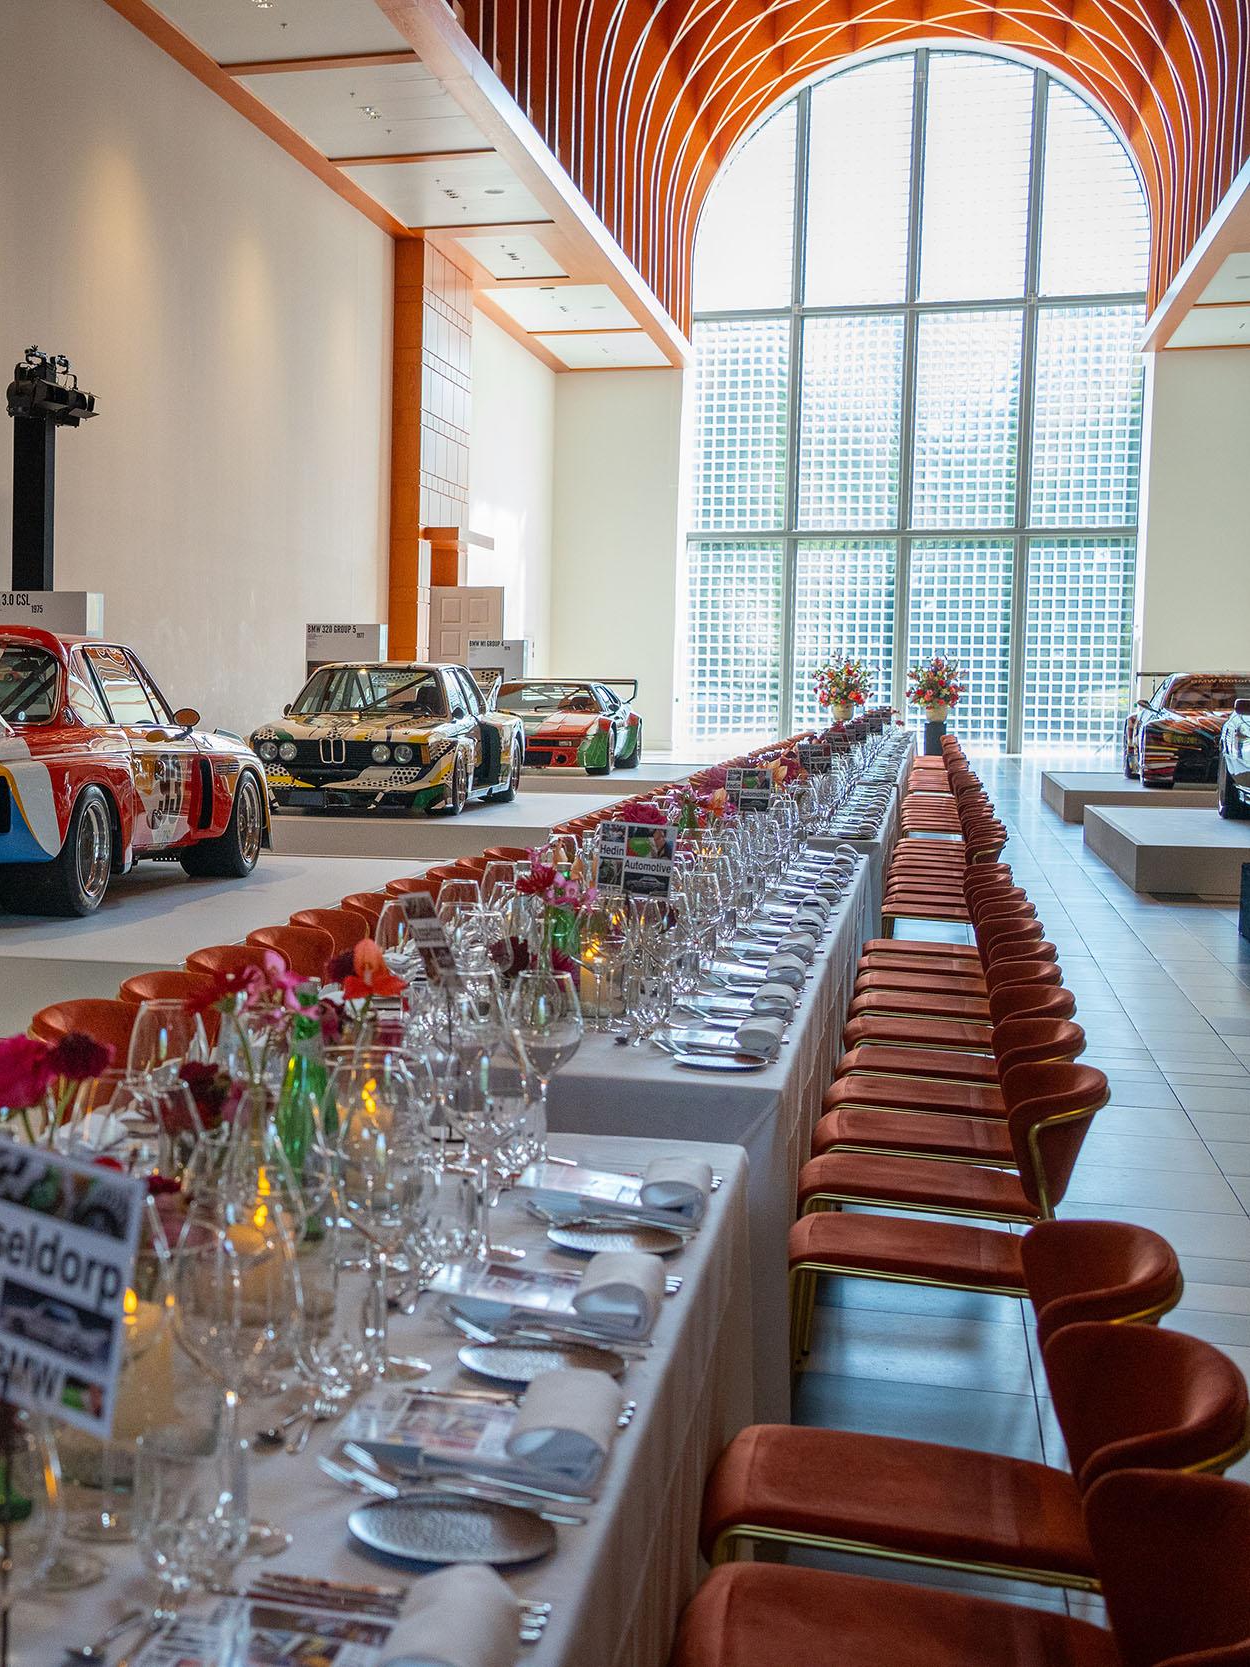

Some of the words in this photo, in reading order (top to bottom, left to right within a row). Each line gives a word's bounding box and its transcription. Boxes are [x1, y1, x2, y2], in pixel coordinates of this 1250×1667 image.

[2, 593, 14, 605] 3.0
[16, 593, 30, 605] CSL
[31, 604, 44, 613] 1975
[307, 625, 321, 633] BMW
[322, 625, 333, 633] 320
[333, 625, 351, 633] GROUP
[352, 625, 357, 633] 5
[600, 844, 624, 856] Hedin
[624, 859, 672, 874] Automotive
